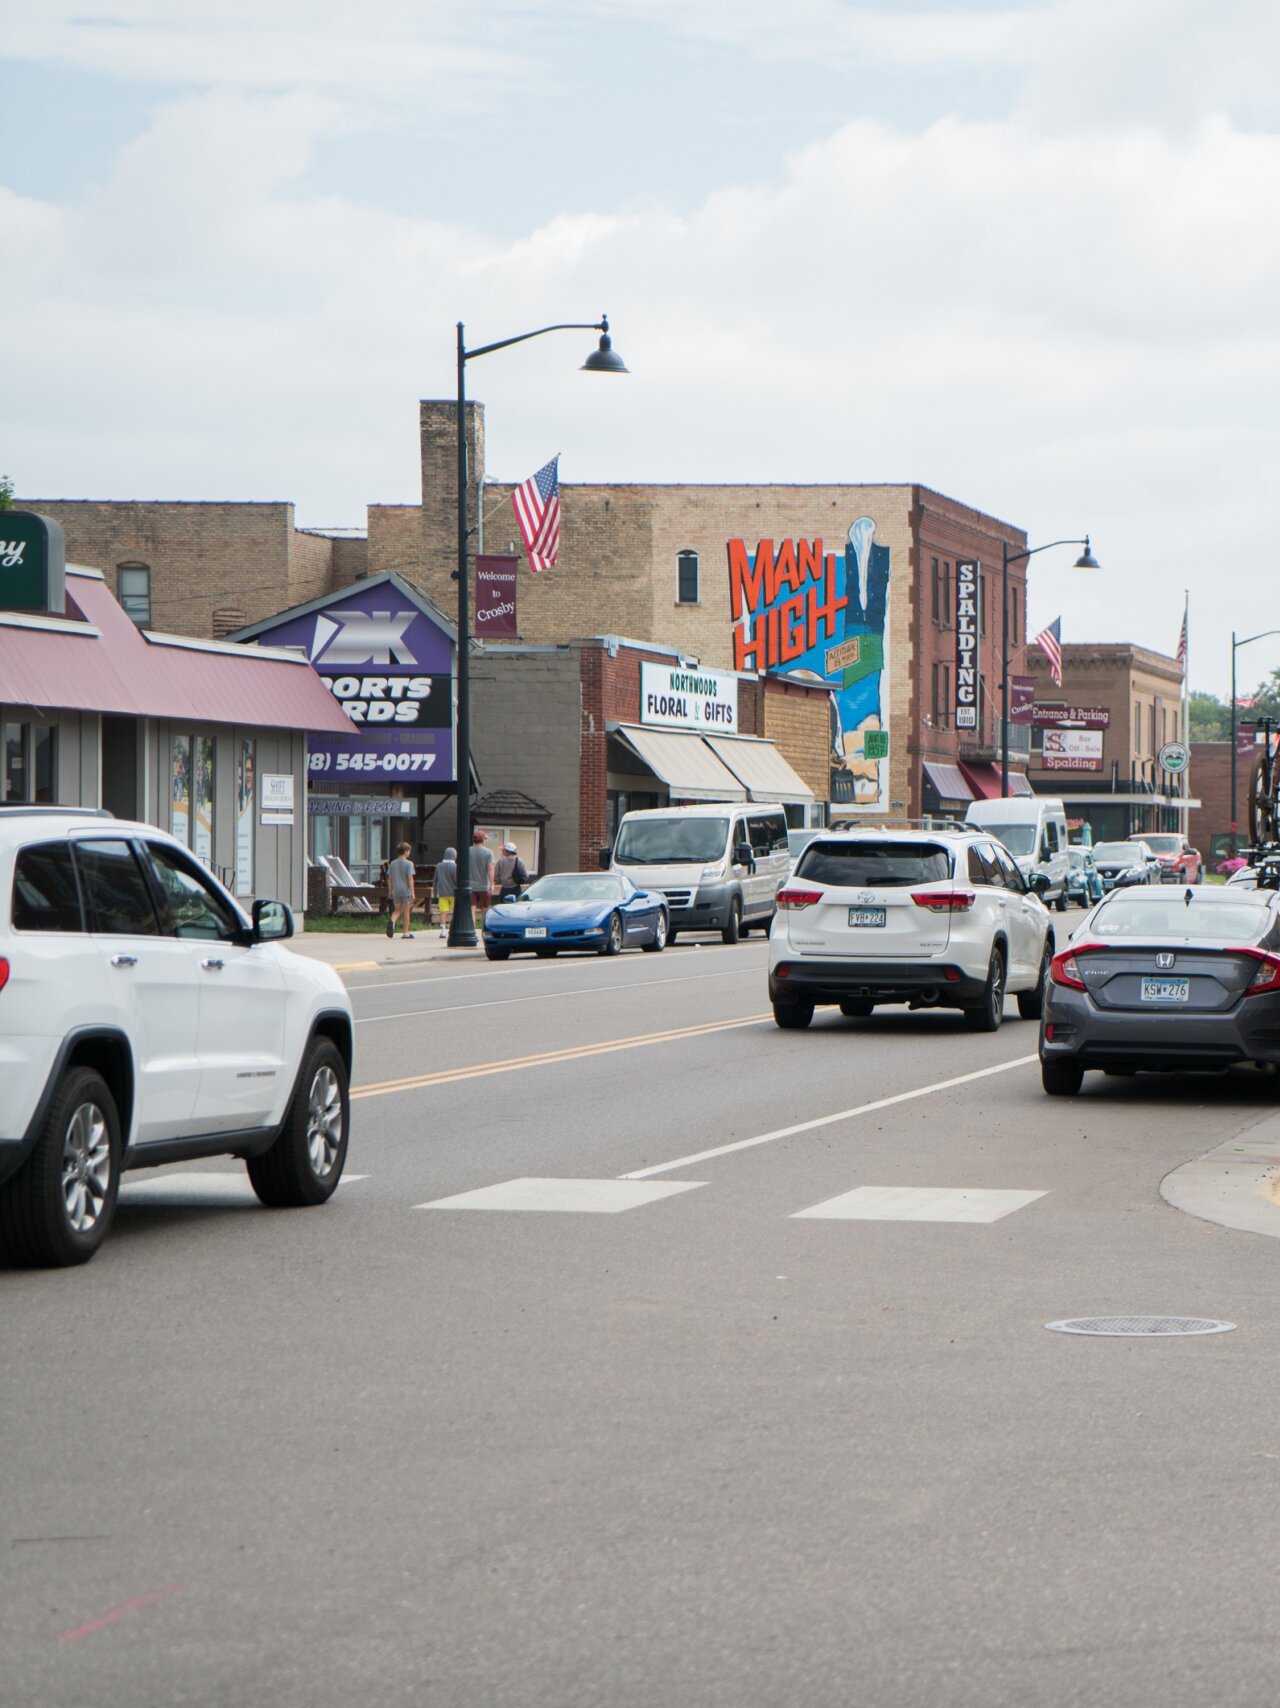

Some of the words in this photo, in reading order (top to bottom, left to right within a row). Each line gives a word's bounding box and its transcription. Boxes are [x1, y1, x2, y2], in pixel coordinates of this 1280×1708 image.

[478, 571, 516, 581] Welcome
[727, 538, 823, 622] MAN
[492, 589, 501, 598] to
[477, 602, 515, 621] Crosby
[732, 553, 848, 672] HIGH
[957, 564, 976, 703] SPALDING
[670, 672, 717, 697] NORTHWOODS
[648, 693, 688, 717] FLORAL
[704, 701, 733, 723] GIFTS
[1032, 707, 1068, 720] Entrance
[1069, 708, 1076, 720] &
[1077, 708, 1109, 722] Parking
[958, 715, 973, 725] 1910
[336, 753, 436, 771] 545-0077
[1047, 757, 1097, 770] Spalding
[1168, 984, 1186, 996] 276
